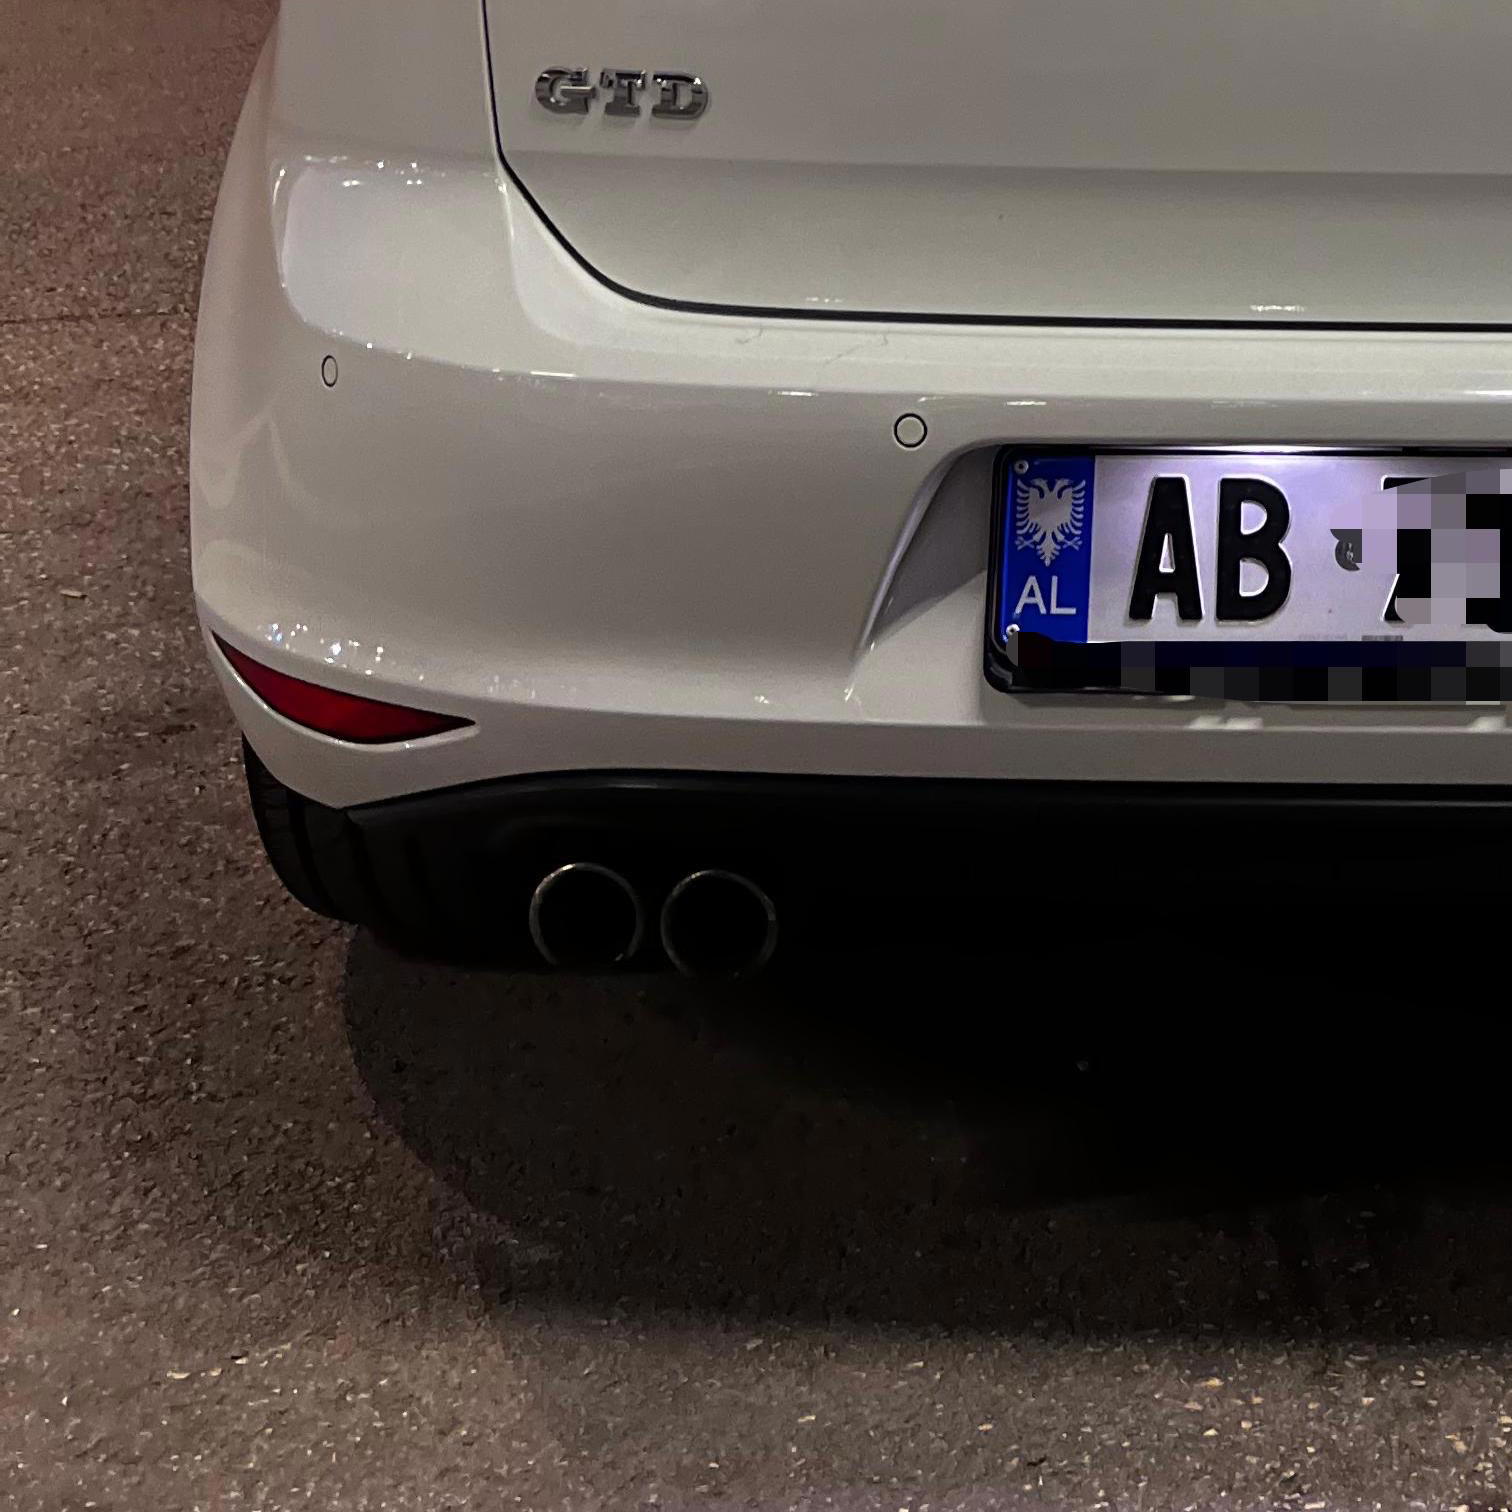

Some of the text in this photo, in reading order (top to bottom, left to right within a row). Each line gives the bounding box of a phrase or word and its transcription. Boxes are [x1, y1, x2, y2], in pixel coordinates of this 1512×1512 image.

[535, 66, 709, 120] GTD
[1015, 575, 1077, 615] AL
[1128, 476, 1292, 622] AB
